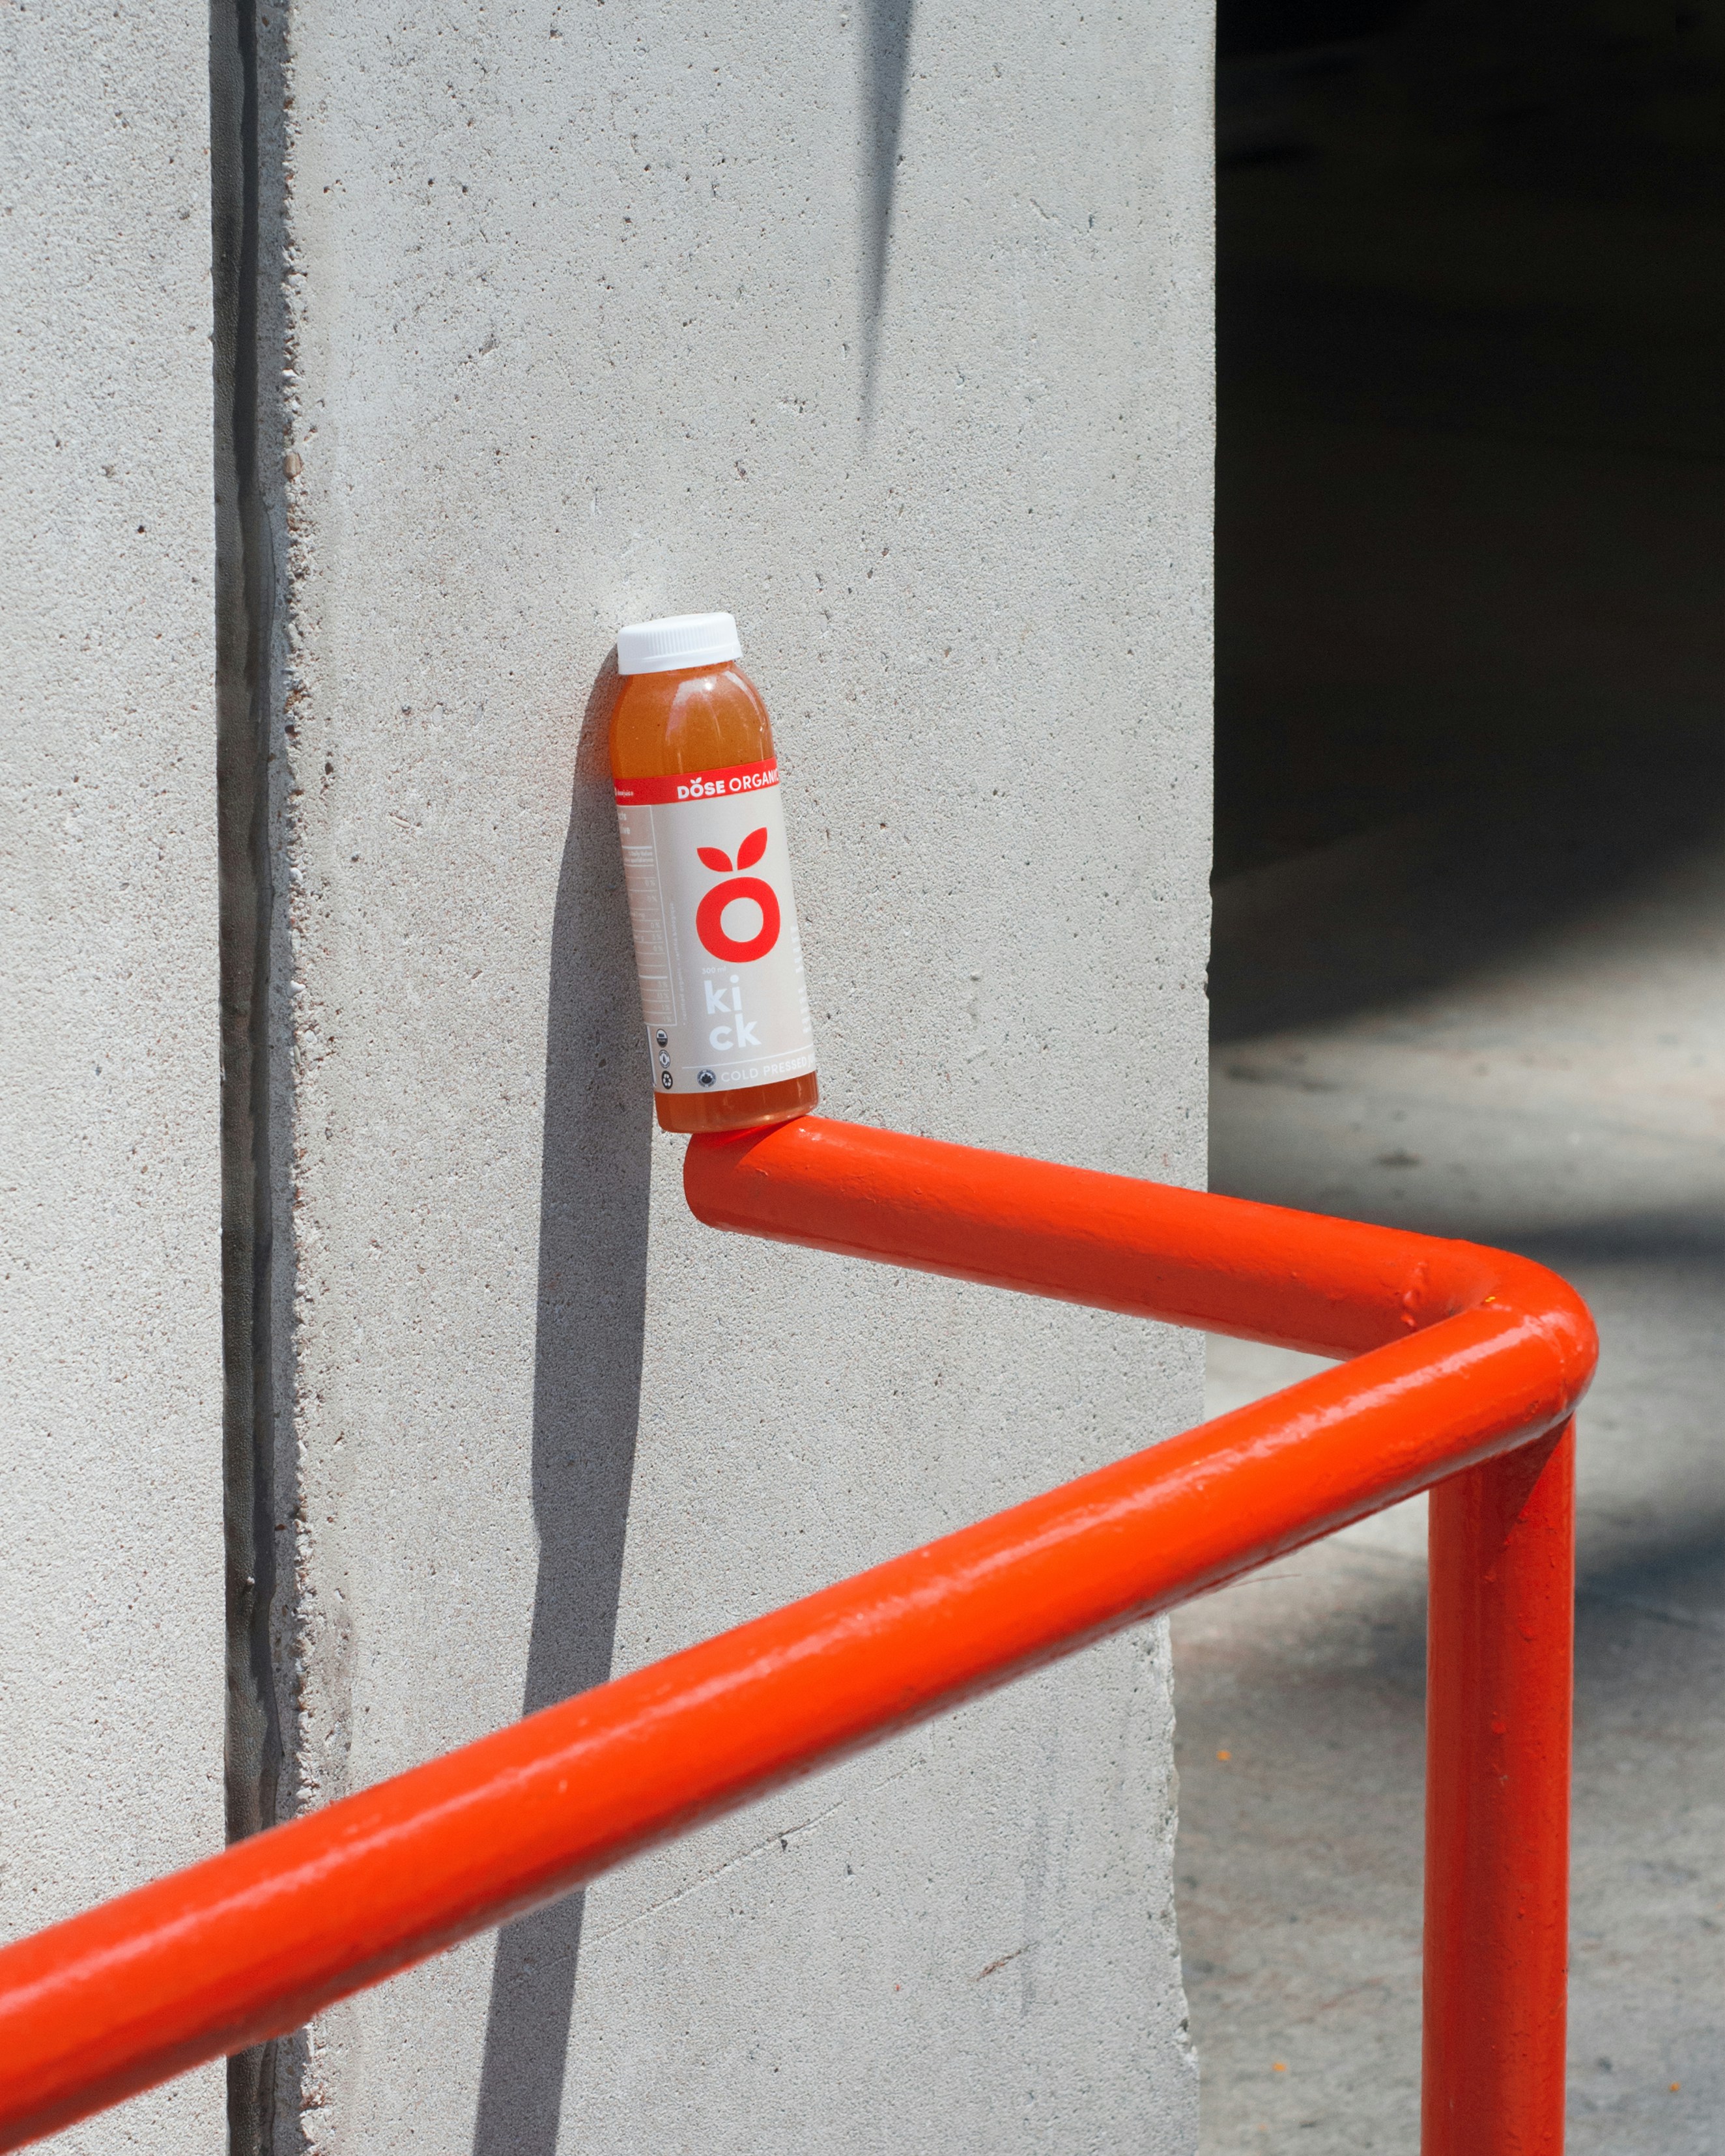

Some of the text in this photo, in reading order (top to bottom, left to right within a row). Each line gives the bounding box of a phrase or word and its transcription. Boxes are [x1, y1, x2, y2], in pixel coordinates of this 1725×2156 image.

[701, 967, 716, 975] 300
[704, 974, 743, 1015] ki
[709, 1014, 762, 1051] ck
[721, 1068, 758, 1083] COLD
[763, 1057, 807, 1077] PRESSED
